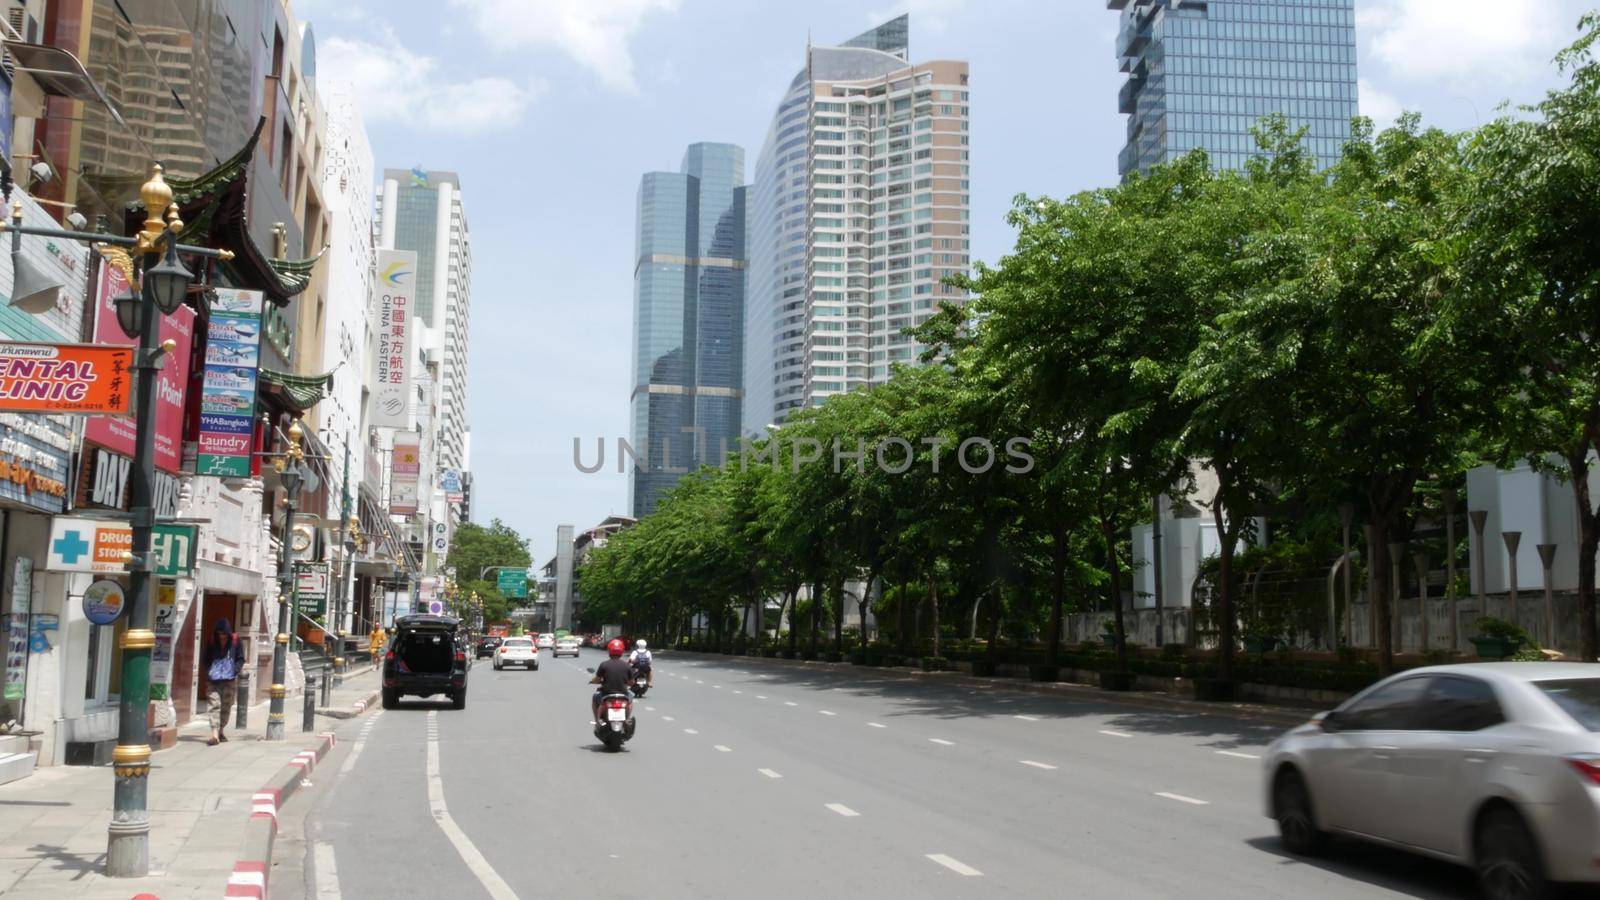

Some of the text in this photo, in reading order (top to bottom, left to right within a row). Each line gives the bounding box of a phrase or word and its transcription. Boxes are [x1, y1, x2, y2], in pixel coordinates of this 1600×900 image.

[379, 294, 391, 383] CHINA EASTERN
[389, 295, 406, 385] 中國東方航空
[207, 354, 239, 363] Ticket
[161, 377, 182, 408] Point
[207, 379, 241, 388] Ticket
[199, 434, 248, 450] Laundry
[92, 449, 131, 510] DAY
[99, 532, 133, 544] DRUG
